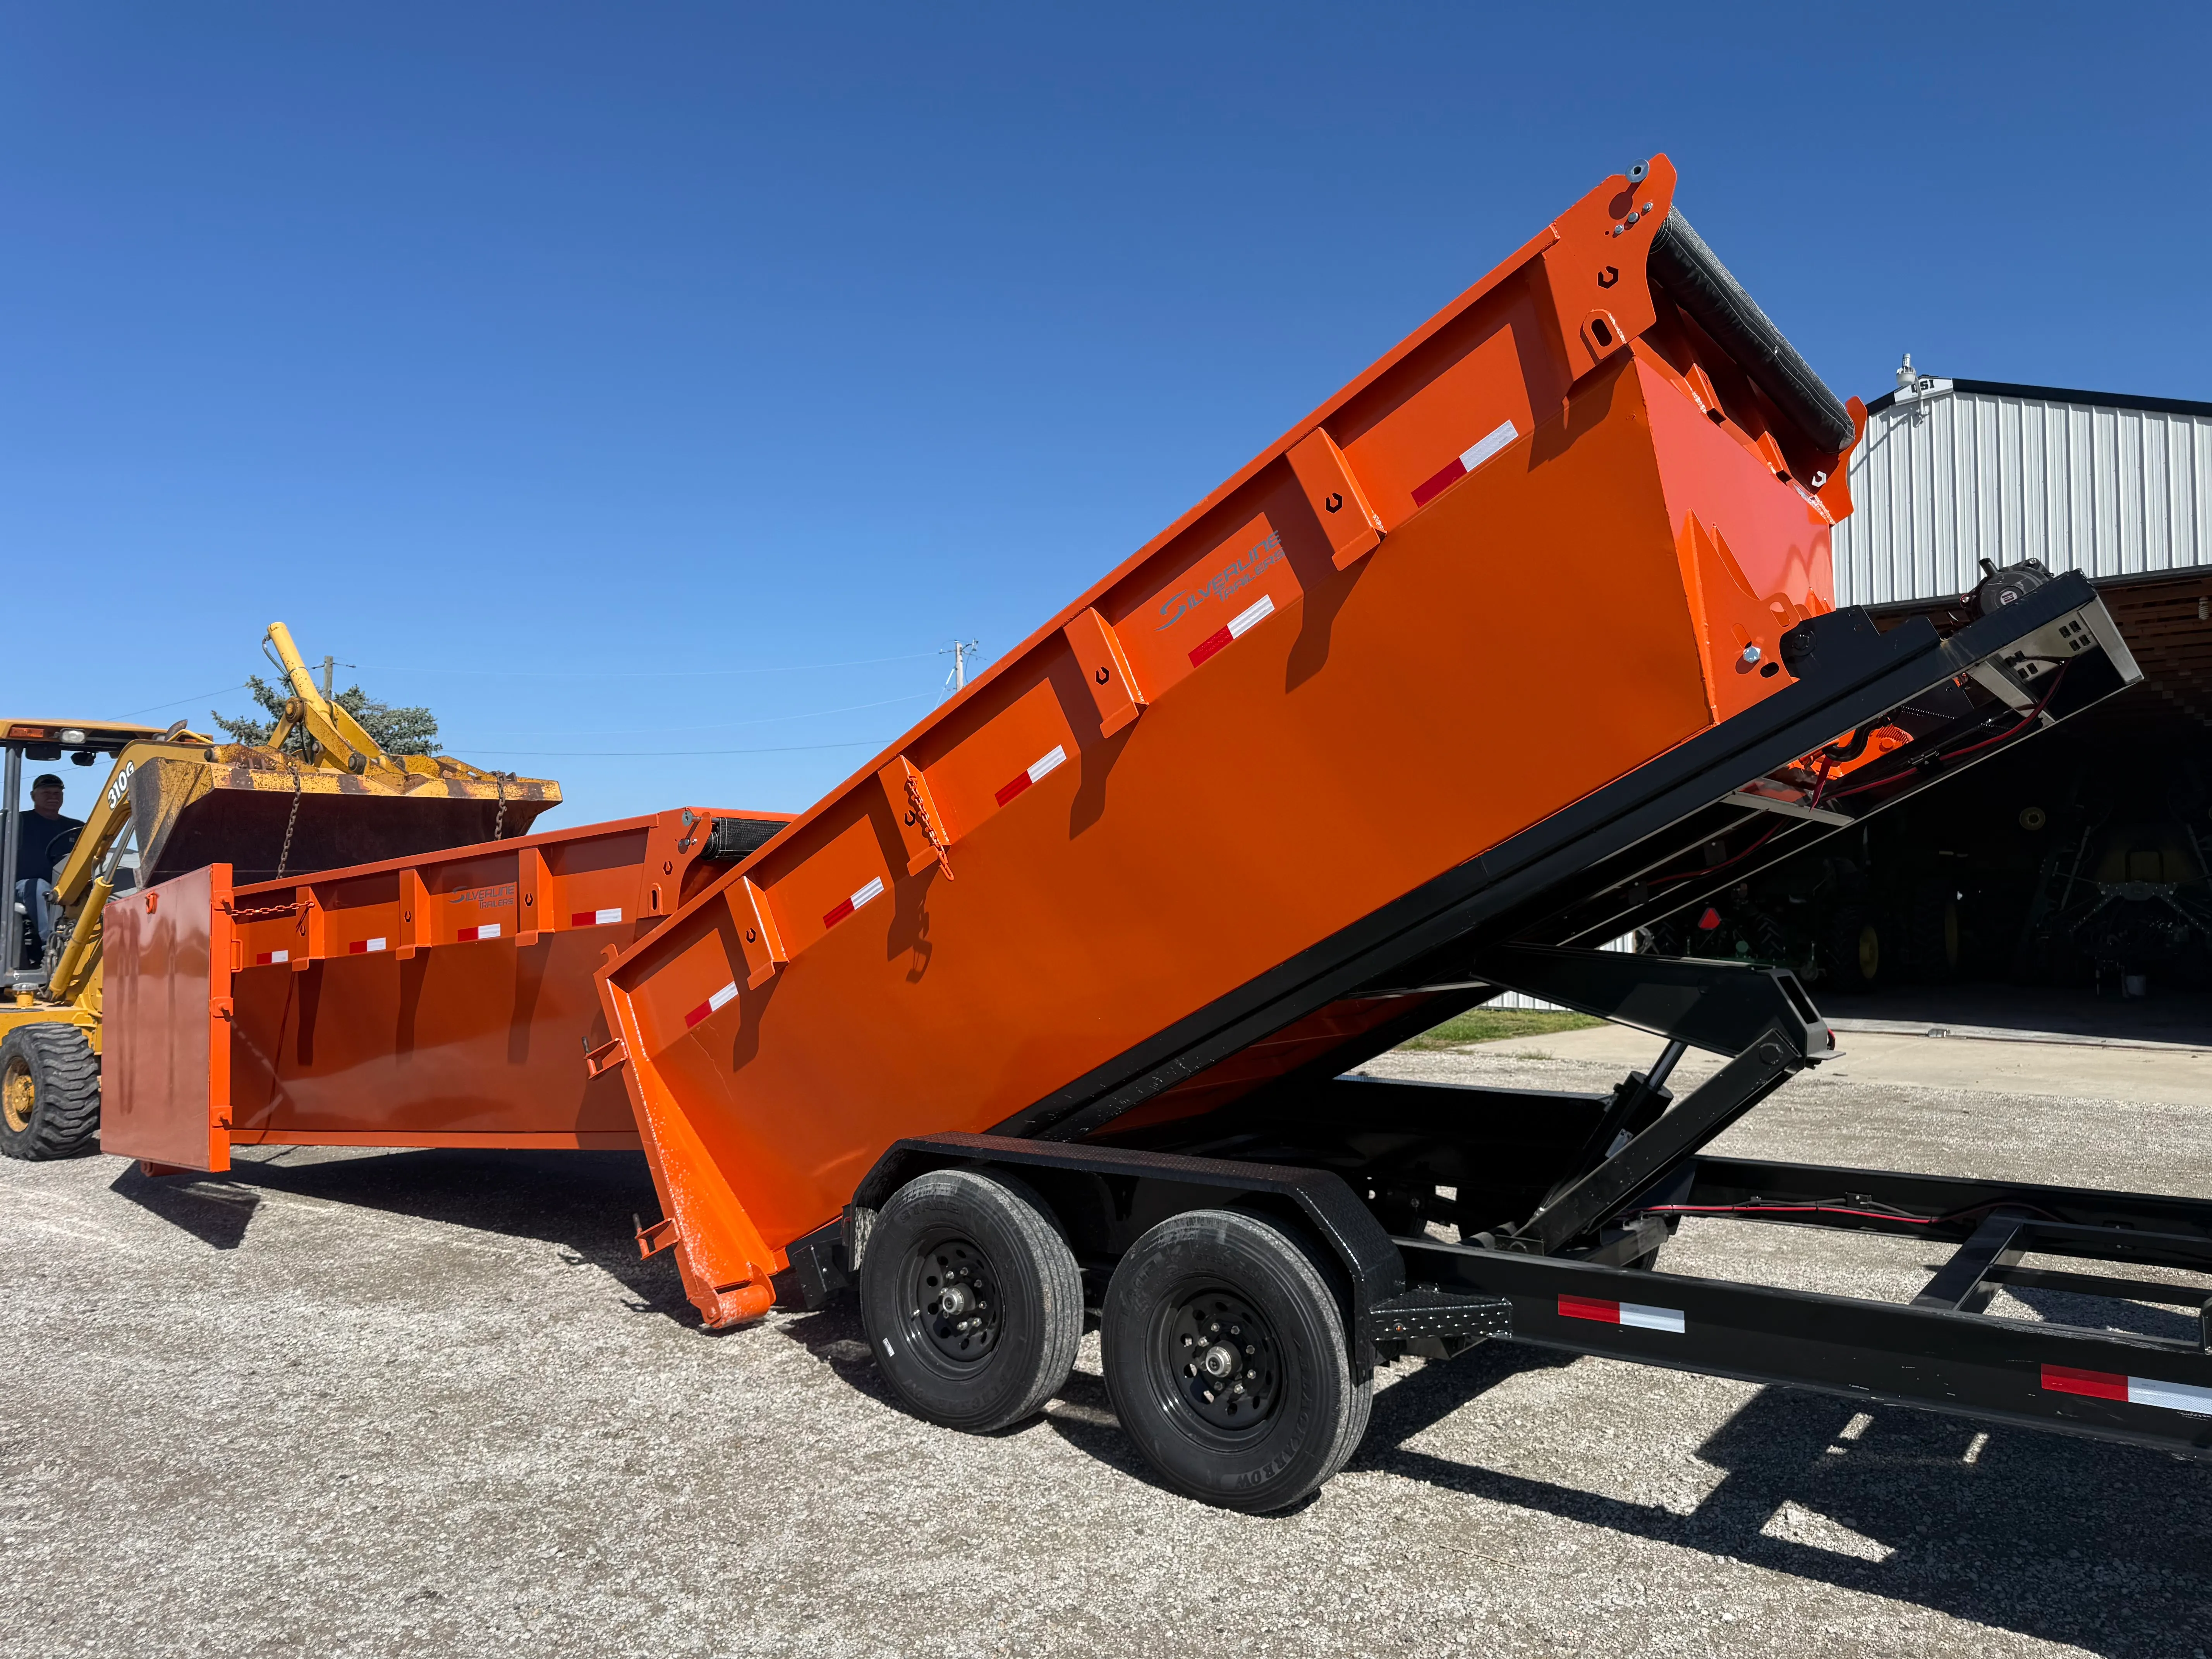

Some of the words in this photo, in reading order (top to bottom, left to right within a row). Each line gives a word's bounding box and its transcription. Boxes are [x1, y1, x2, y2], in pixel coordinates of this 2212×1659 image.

[1154, 530, 1281, 632] SILVERLINE
[1214, 547, 1285, 602] TRAILERS
[108, 761, 134, 809] 310G
[447, 885, 515, 904] SILVERLINE
[478, 898, 514, 909] TRAILERS
